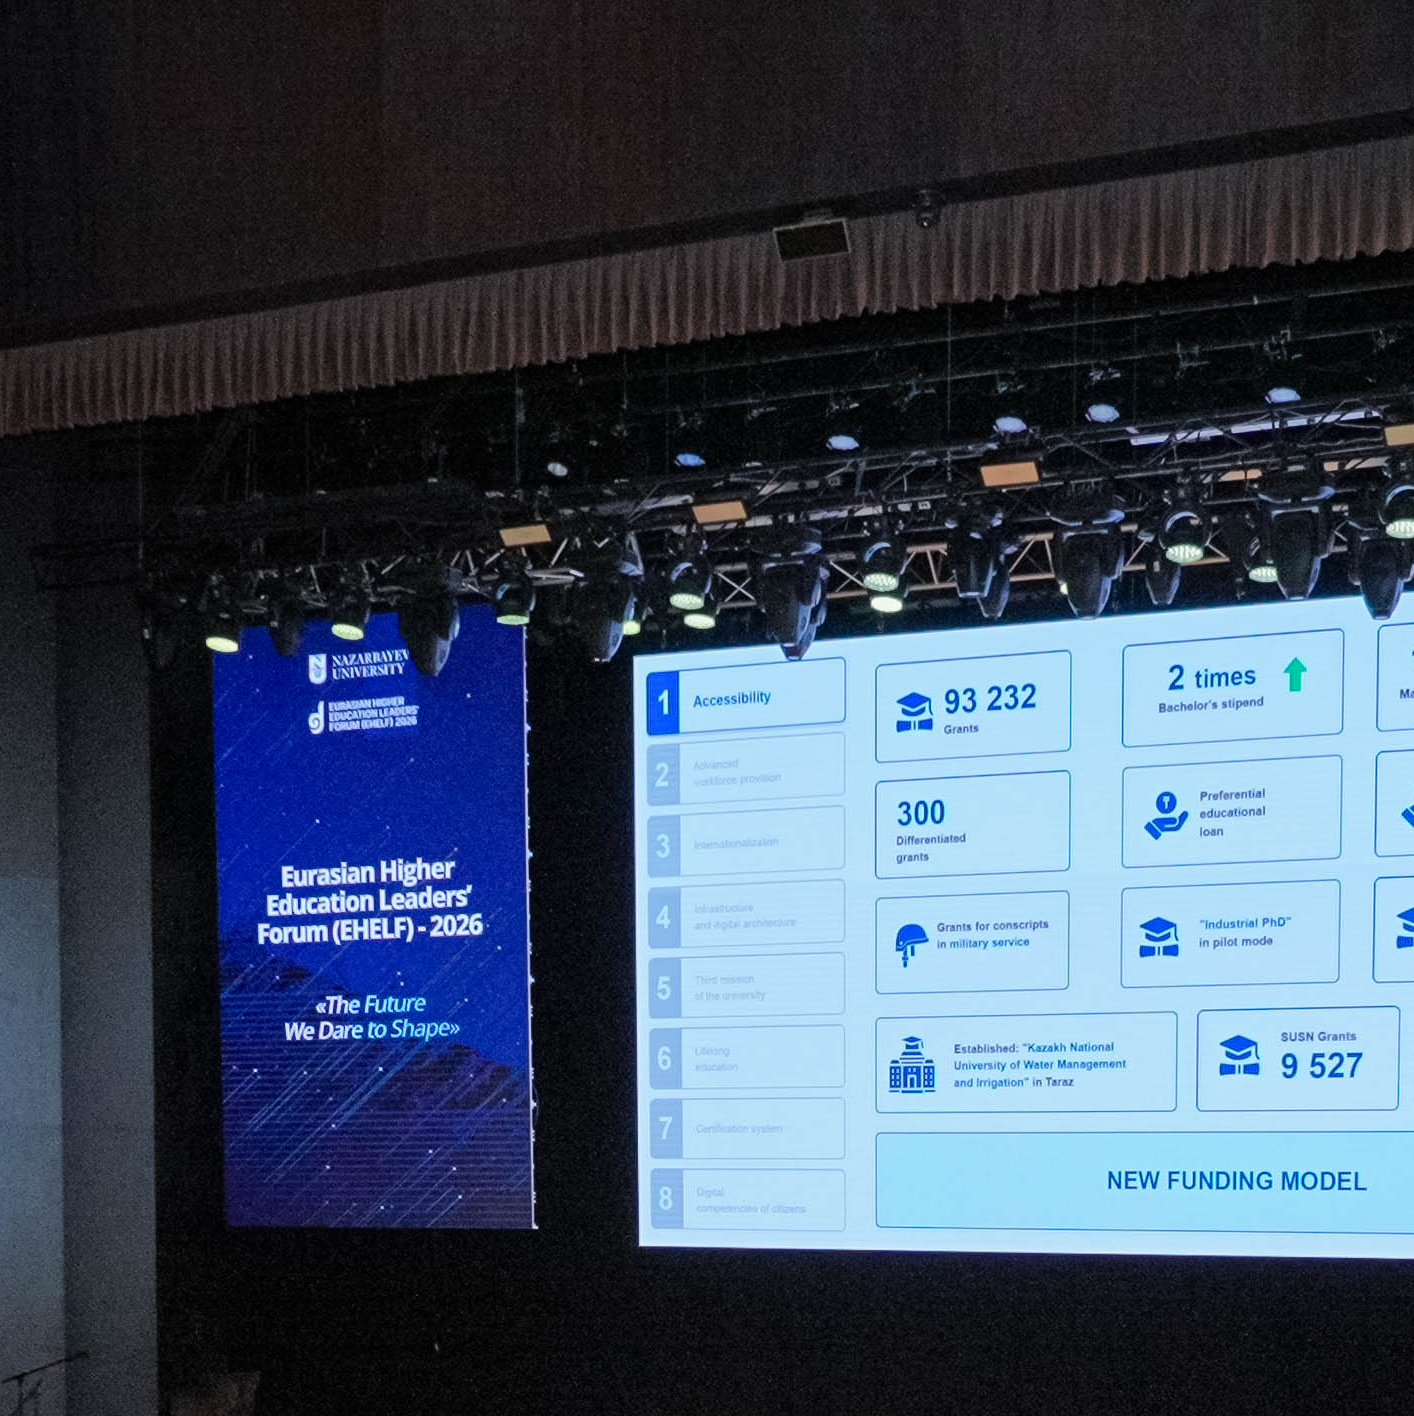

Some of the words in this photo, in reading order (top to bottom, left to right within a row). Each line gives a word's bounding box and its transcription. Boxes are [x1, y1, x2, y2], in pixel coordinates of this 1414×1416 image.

[332, 648, 409, 667] NAZARBAYEV
[332, 662, 405, 680] UNIVERSITY
[1168, 664, 1185, 691] 2
[1195, 665, 1257, 689] times
[658, 689, 670, 715] 1
[693, 690, 771, 708] Accessibility
[944, 686, 977, 714] 93
[987, 683, 1037, 711] 232
[1158, 699, 1218, 714] Bachelor's
[1221, 696, 1264, 712] stipend
[329, 708, 378, 722] EDUCATION
[329, 720, 360, 732] FORUM
[944, 722, 979, 736] Grants
[655, 762, 669, 788] 2
[1200, 787, 1266, 801] Preferential
[896, 799, 945, 826] 300
[1199, 806, 1266, 819] educational
[896, 832, 966, 847] Differentiated
[1199, 826, 1224, 838] loan
[656, 833, 670, 858] 3
[896, 852, 929, 865] grants
[281, 861, 377, 890] Eurasian
[380, 858, 455, 889] Higher
[266, 888, 374, 917] Education
[656, 904, 671, 929] 4
[937, 920, 972, 933] Grants
[975, 920, 992, 932] for
[994, 918, 1049, 934] conscripts
[1199, 917, 1259, 931] "Industrial
[1261, 916, 1292, 929] PhD"
[258, 920, 327, 945] Forum
[332, 916, 415, 947] (EHELF)
[430, 914, 483, 939] 2026
[937, 938, 947, 949] in
[949, 937, 989, 951] military
[992, 936, 1030, 948] service
[1199, 936, 1210, 948] in
[1212, 936, 1238, 950] pilot
[1240, 935, 1273, 948] mode
[657, 976, 671, 1000] 5
[315, 995, 361, 1016] «The
[365, 993, 426, 1015] Future
[285, 1021, 315, 1042] We
[319, 1020, 364, 1041] Dare
[367, 1021, 388, 1040] to
[391, 1018, 460, 1044] Shape»
[1281, 1031, 1315, 1043] SUSN
[1317, 1030, 1357, 1043] Grants
[954, 1041, 1020, 1054] Established:
[1022, 1041, 1067, 1053] "Kazakh
[1070, 1040, 1115, 1053] National
[657, 1046, 672, 1071] 6
[954, 1058, 1007, 1073] University
[1009, 1058, 1021, 1071] of
[1023, 1058, 1055, 1070] Water
[1057, 1058, 1127, 1073] Management
[1281, 1053, 1298, 1079] 9
[1309, 1052, 1364, 1079] 527
[954, 1076, 973, 1089] and
[976, 1076, 1030, 1091] Irrigation"
[1032, 1076, 1042, 1088] in
[1044, 1076, 1075, 1088] Taraz
[658, 1116, 673, 1140] 7
[1107, 1171, 1159, 1190] NEW
[1167, 1171, 1274, 1191] FUNDING
[1281, 1171, 1368, 1191] MODEL
[658, 1186, 673, 1210] 8
